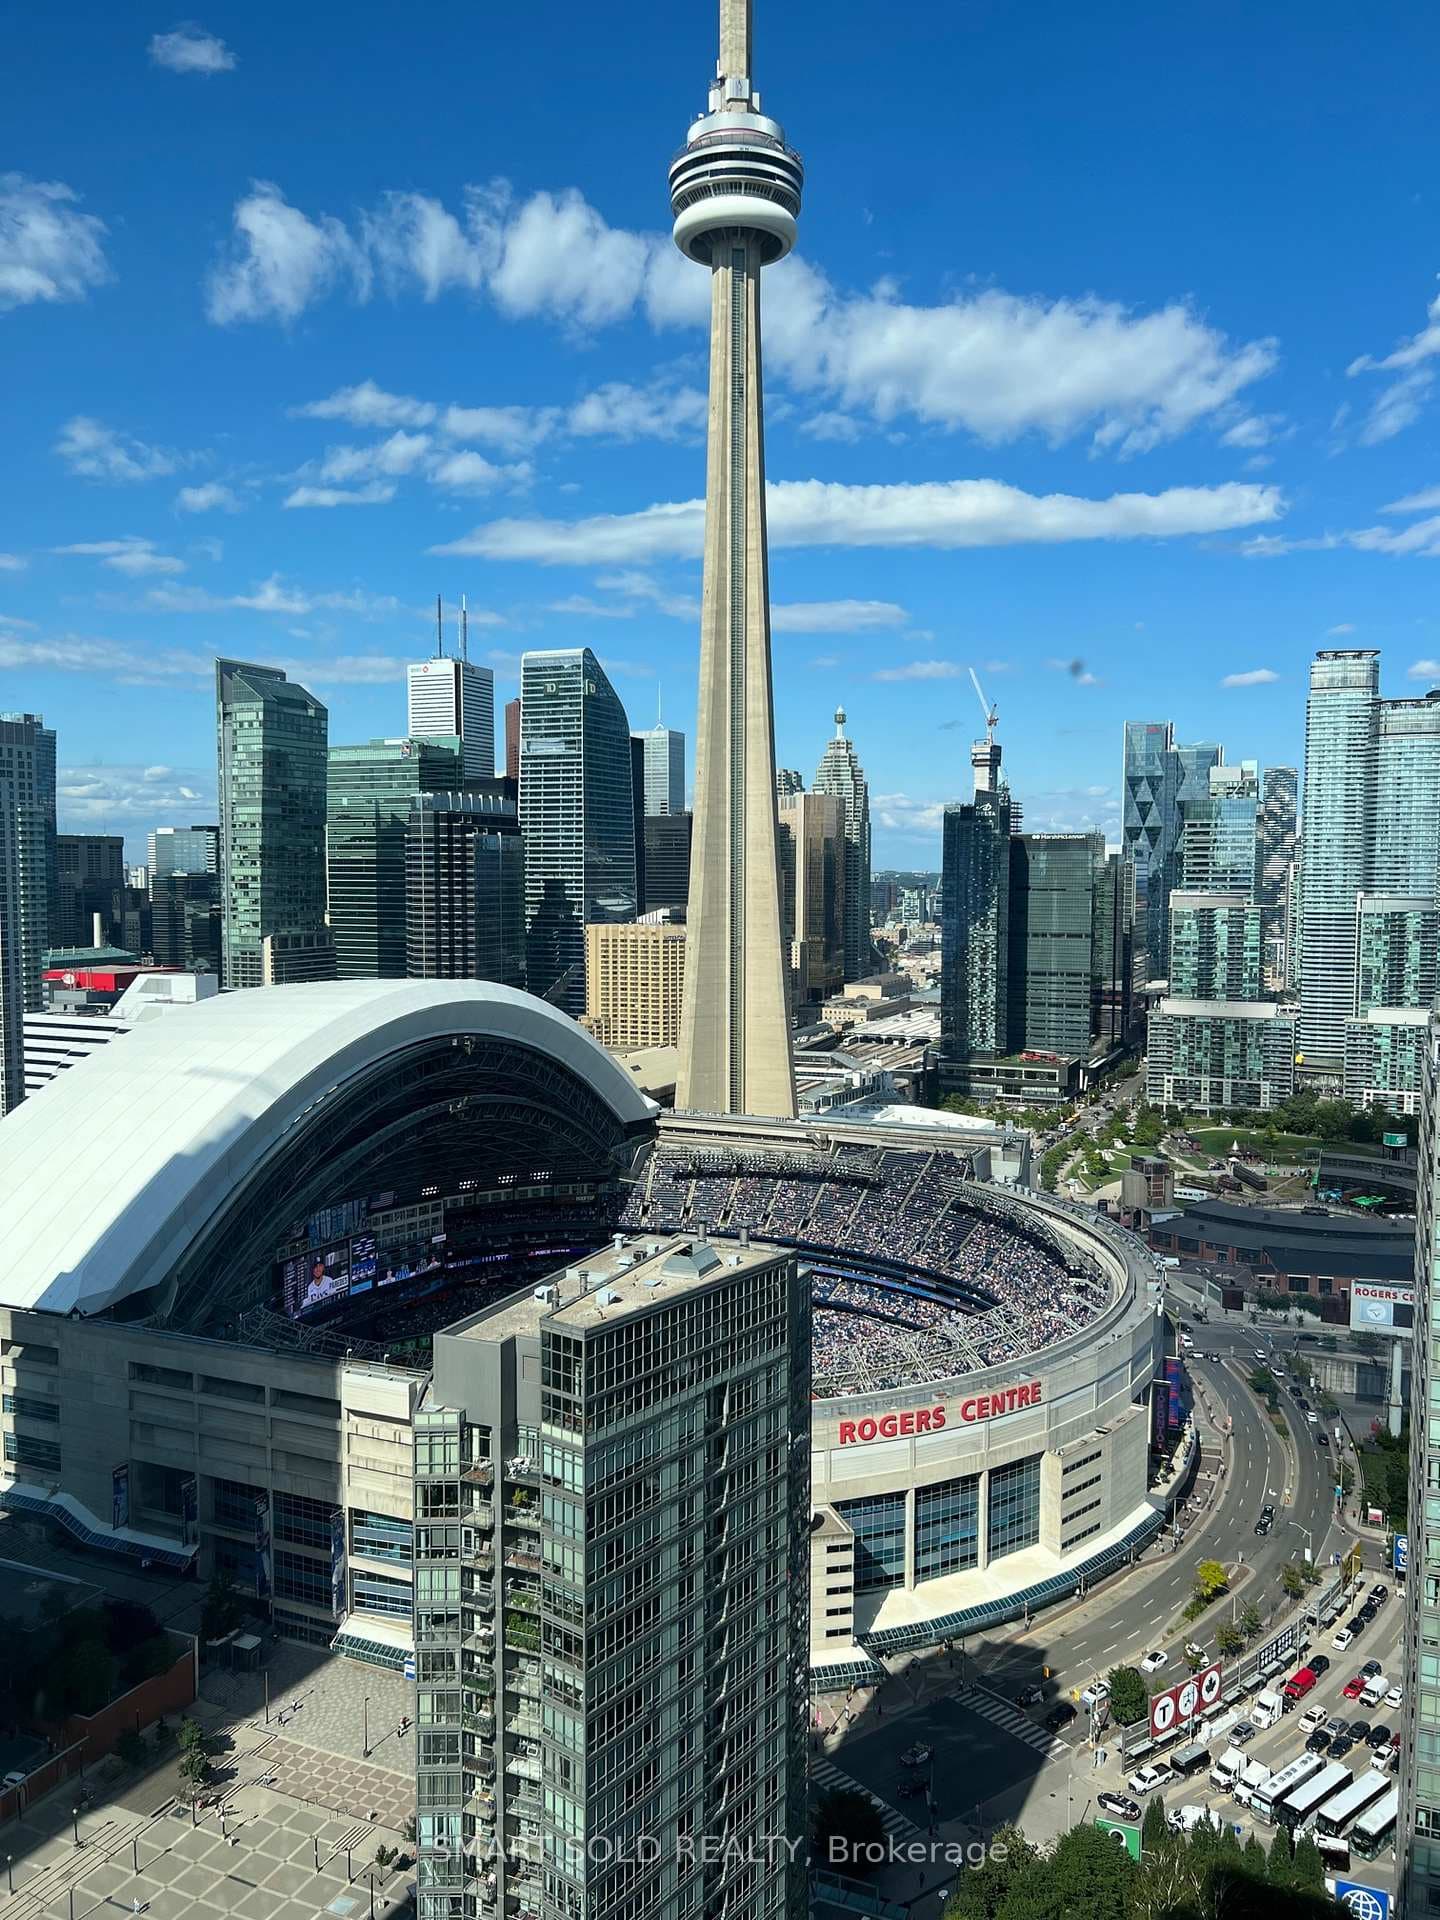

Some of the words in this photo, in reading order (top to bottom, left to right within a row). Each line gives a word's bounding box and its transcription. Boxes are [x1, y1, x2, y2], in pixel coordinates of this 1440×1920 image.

[544, 682, 557, 693] TD
[1354, 1288, 1398, 1300] ROGERS
[839, 1406, 945, 1444] ROGERS
[960, 1382, 1042, 1422] CENTRE
